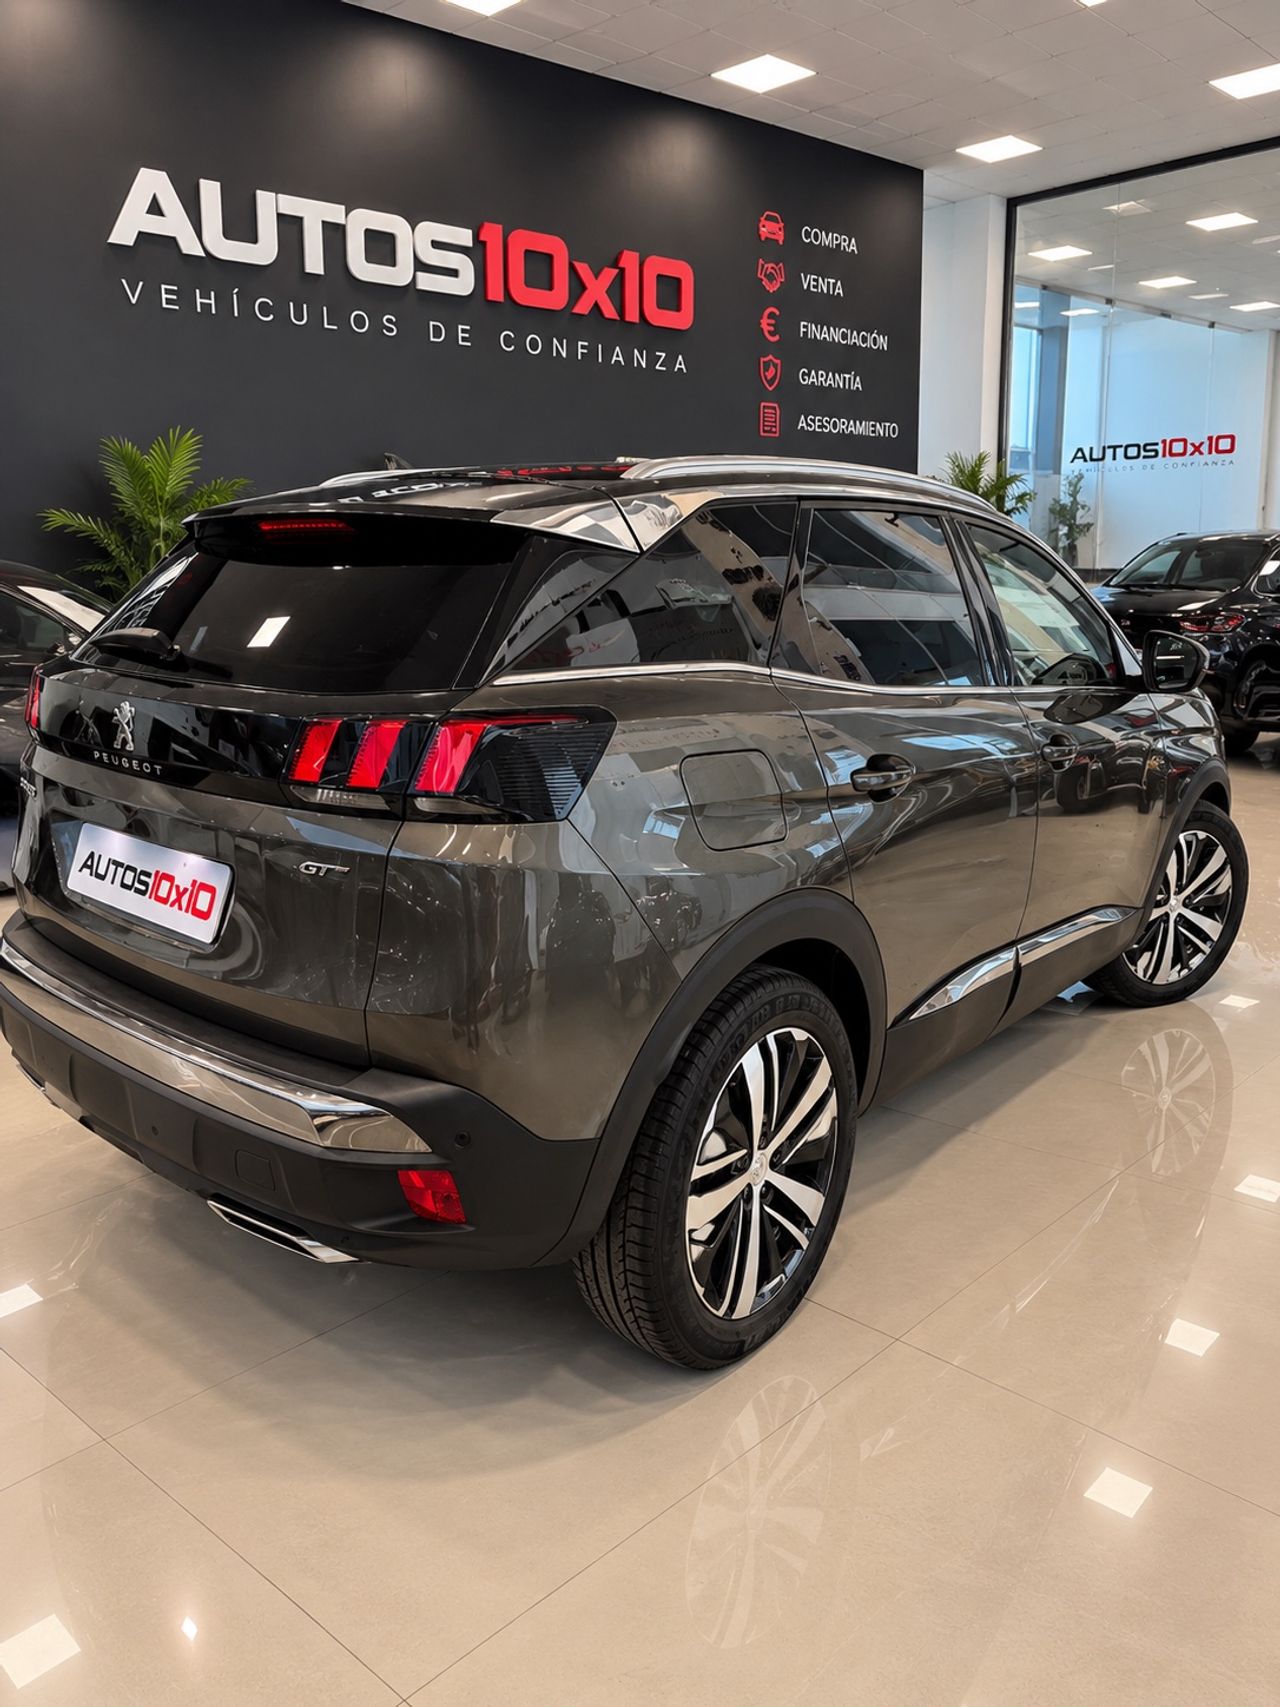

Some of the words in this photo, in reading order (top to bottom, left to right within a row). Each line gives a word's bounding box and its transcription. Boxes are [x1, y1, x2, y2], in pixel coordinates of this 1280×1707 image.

[107, 167, 695, 331] AUTOS10x10
[801, 226, 858, 254] COMPRA
[800, 273, 844, 297] VENTA
[120, 278, 399, 337] VEHÍCULOS
[429, 321, 472, 347] DE
[499, 330, 689, 374] CONFIANZA
[799, 321, 888, 351] FINANCIACIÓN
[798, 368, 863, 391] GARANTÍA
[797, 414, 899, 438] ASESORAMIENTO
[1070, 434, 1236, 464] AUTOS10x10
[93, 750, 162, 775] PEUGEOT
[78, 850, 217, 921] AUTOS10x10
